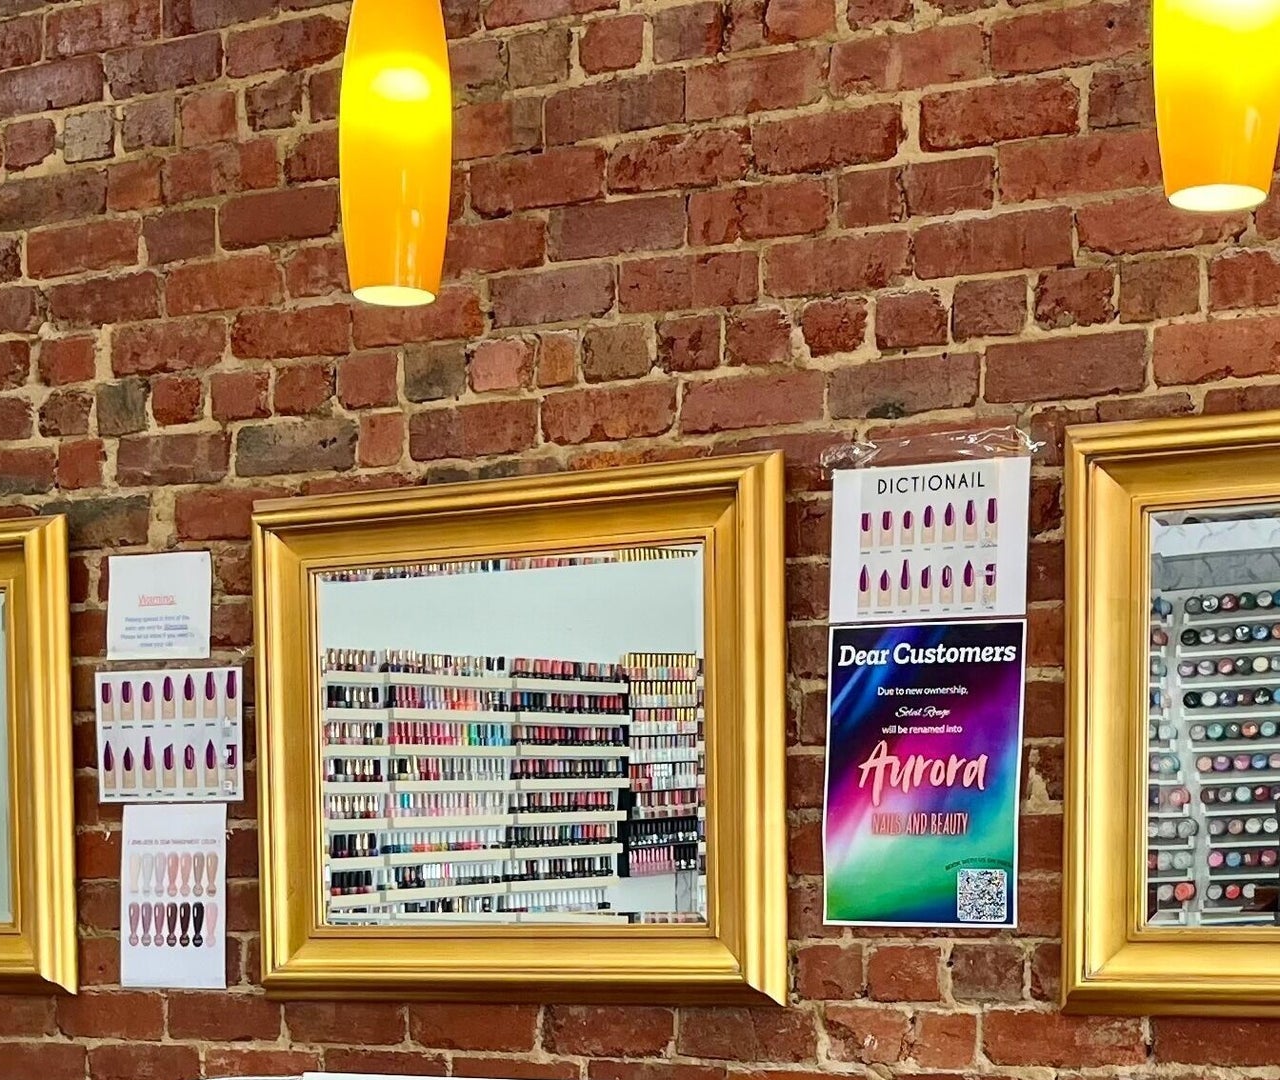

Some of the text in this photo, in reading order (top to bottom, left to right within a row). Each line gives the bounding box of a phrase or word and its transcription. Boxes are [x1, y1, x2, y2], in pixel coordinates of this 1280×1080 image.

[878, 471, 985, 495] DICTIONAIL
[838, 642, 1017, 667] Dear Customers
[877, 686, 894, 696] Due
[895, 687, 904, 696] to
[881, 724, 963, 734] will be renamed into
[858, 739, 989, 806] Aurora
[872, 813, 969, 835] NAILS AND BEAUTY
